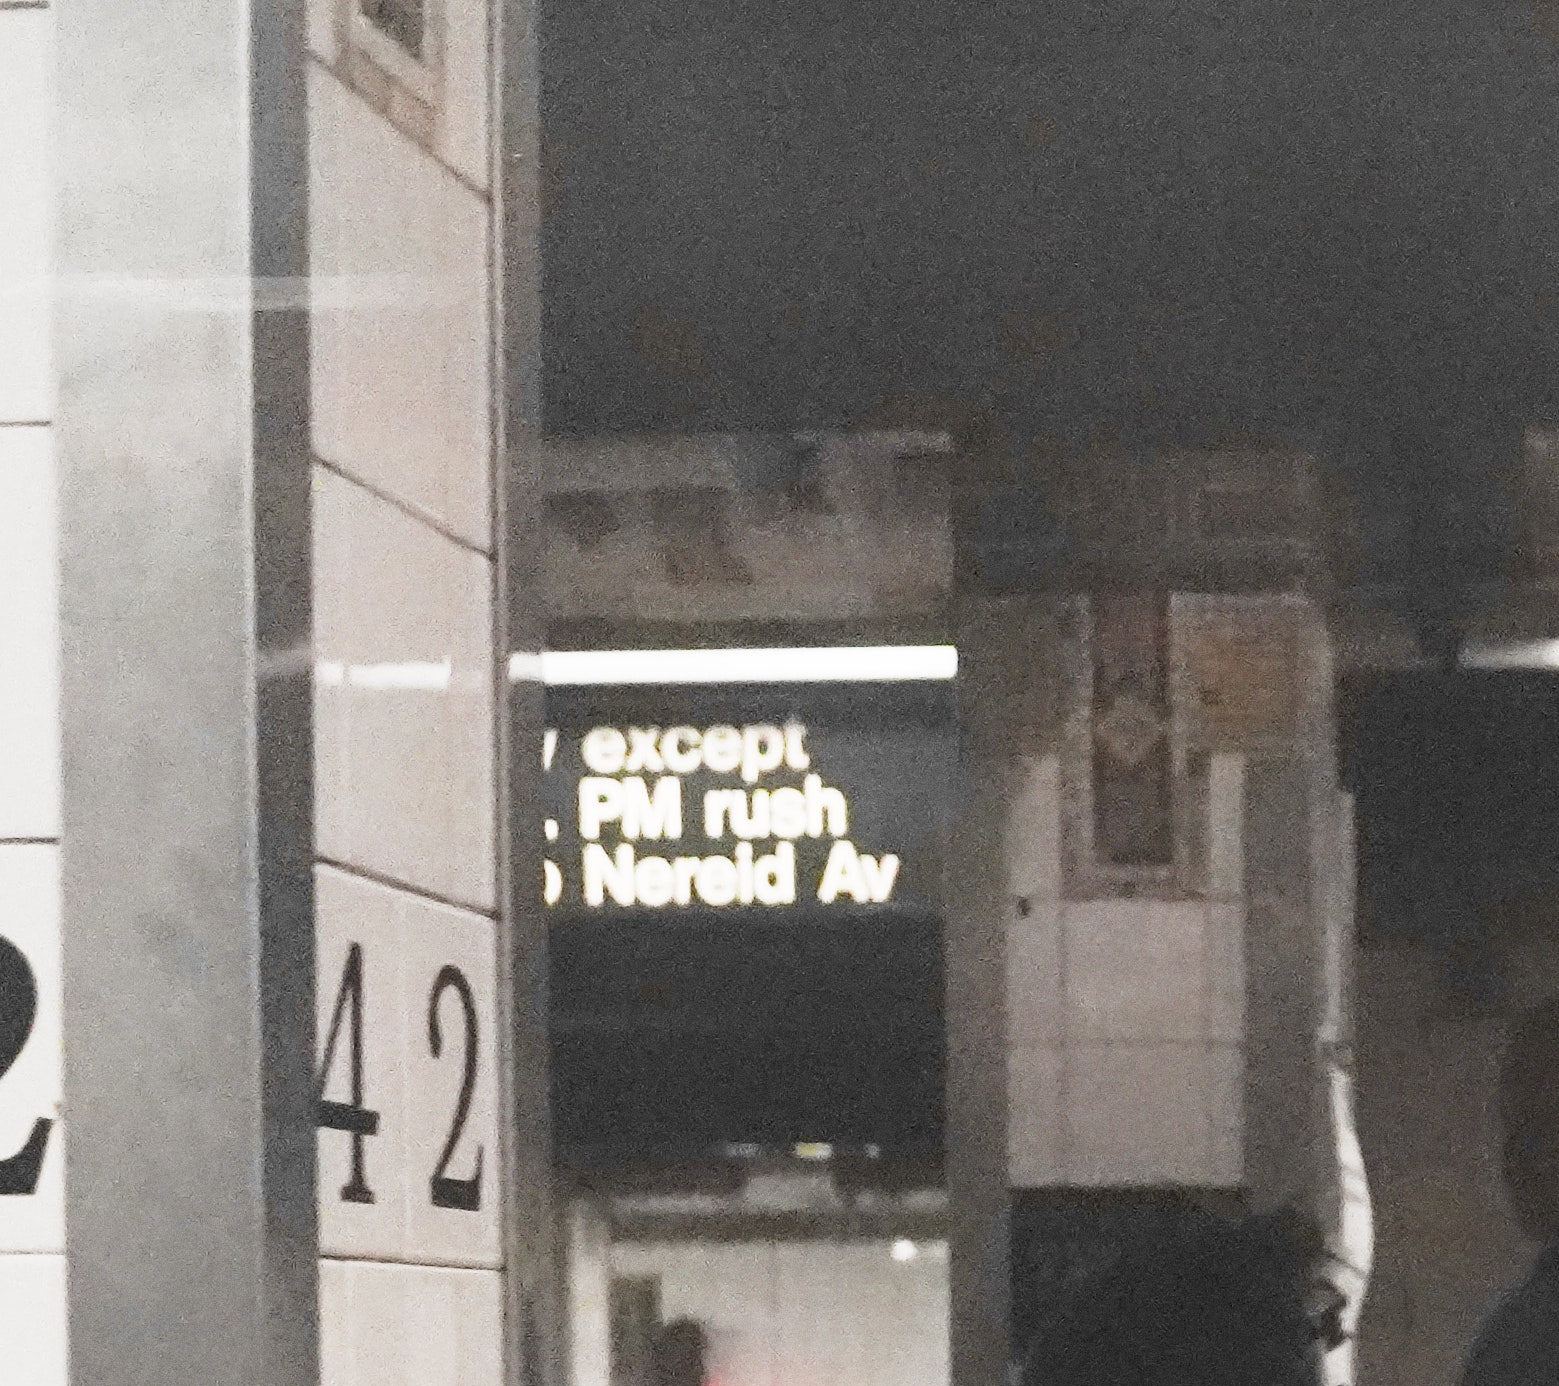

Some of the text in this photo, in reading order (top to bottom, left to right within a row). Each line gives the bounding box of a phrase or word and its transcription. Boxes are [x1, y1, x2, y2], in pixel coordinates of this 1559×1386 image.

[583, 720, 811, 783] except
[579, 774, 848, 840] PM rush
[582, 841, 796, 908] Nereid
[816, 839, 901, 904] Av
